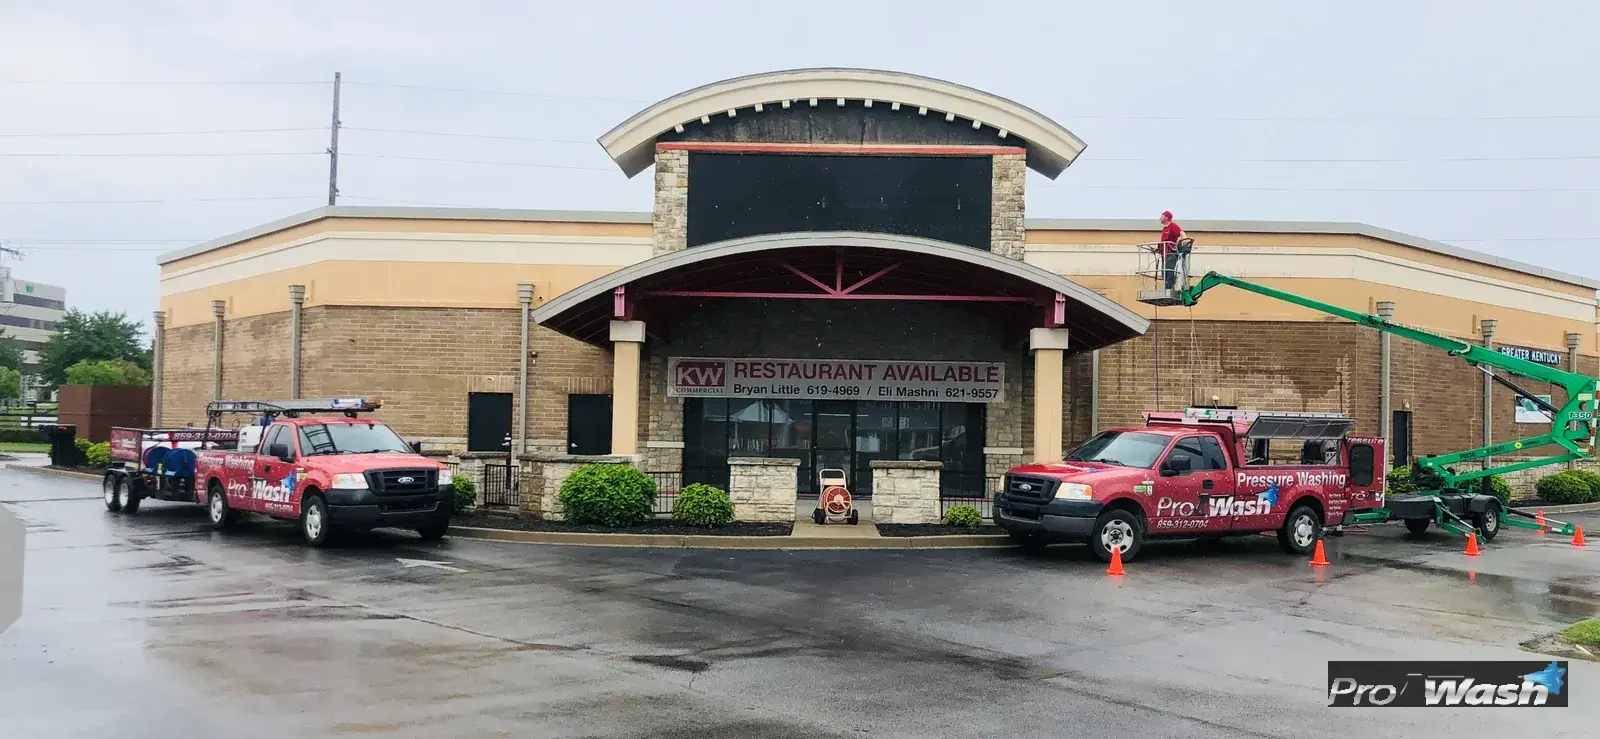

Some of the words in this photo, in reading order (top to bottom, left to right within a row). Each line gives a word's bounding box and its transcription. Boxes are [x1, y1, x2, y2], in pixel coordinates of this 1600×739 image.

[1501, 347, 1530, 360] GREATER
[1531, 350, 1562, 364] KENTUCKY
[676, 365, 725, 387] KW
[733, 362, 877, 381] RESTAURANT
[882, 364, 999, 383] AVAILABLE
[733, 384, 767, 396] Bryan
[771, 384, 800, 395] Little
[807, 384, 860, 396] 619-4969
[866, 385, 872, 396] /
[878, 385, 893, 397] Eli
[896, 385, 939, 398] Mashni
[945, 387, 999, 399] 621-9557
[1346, 436, 1384, 446] ressure
[225, 454, 254, 474] Washing
[1237, 472, 1294, 488] Pressure
[1297, 471, 1346, 488] Washing
[227, 478, 247, 498] Pro
[253, 480, 290, 502] Wash
[1156, 496, 1195, 517] Pro
[1209, 496, 1271, 517] Wash
[1157, 520, 1209, 529] 859-312-0704
